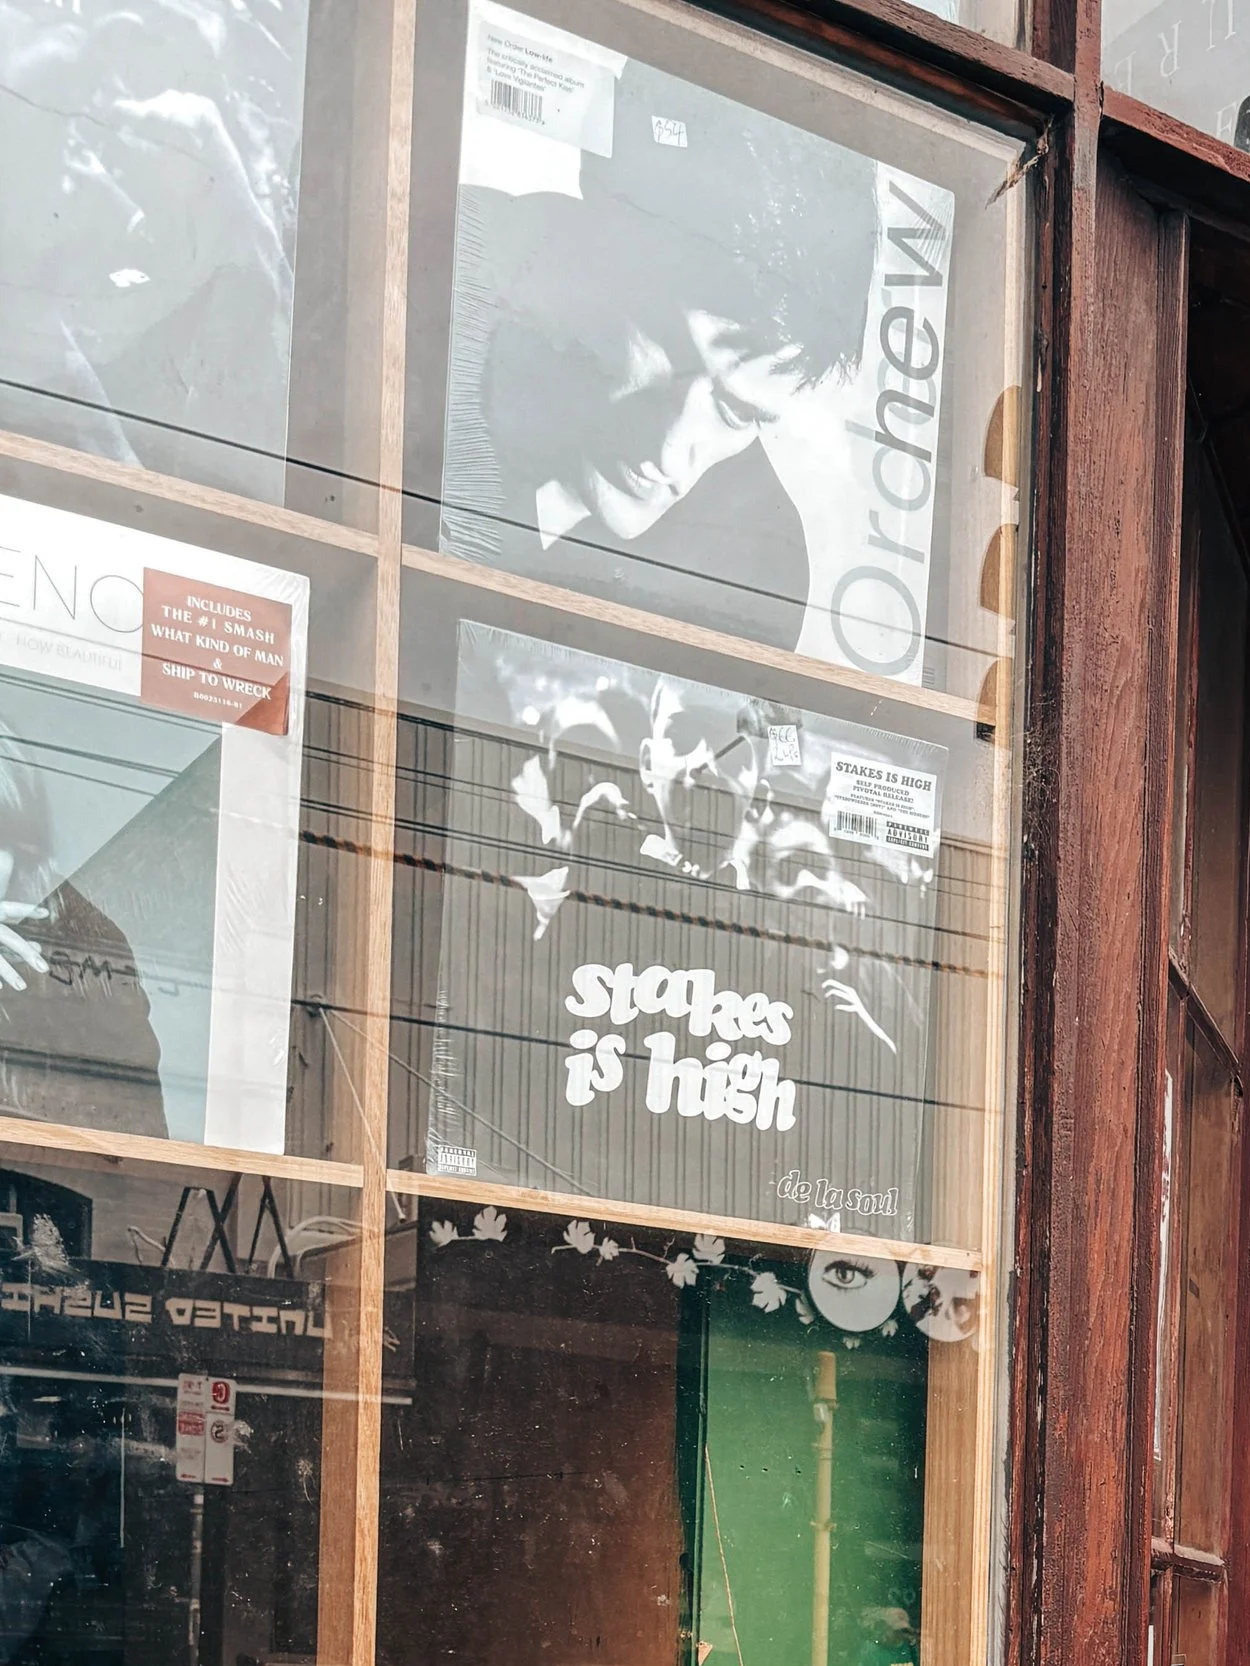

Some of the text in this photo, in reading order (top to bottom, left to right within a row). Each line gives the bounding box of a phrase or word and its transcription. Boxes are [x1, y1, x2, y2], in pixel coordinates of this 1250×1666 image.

[187, 595, 251, 622] INCLUDES
[162, 605, 275, 645] THE #1 SMASH
[151, 623, 284, 667] WHAT KIND OF MAN
[213, 657, 222, 670] &
[162, 662, 272, 700] SHIP TO WRECK
[836, 761, 932, 792] STAKES IS HIGH
[852, 786, 881, 798] PIVOTAL
[856, 779, 910, 796] SELF PRODUCED
[777, 1170, 812, 1203] de
[814, 1178, 845, 1210] la
